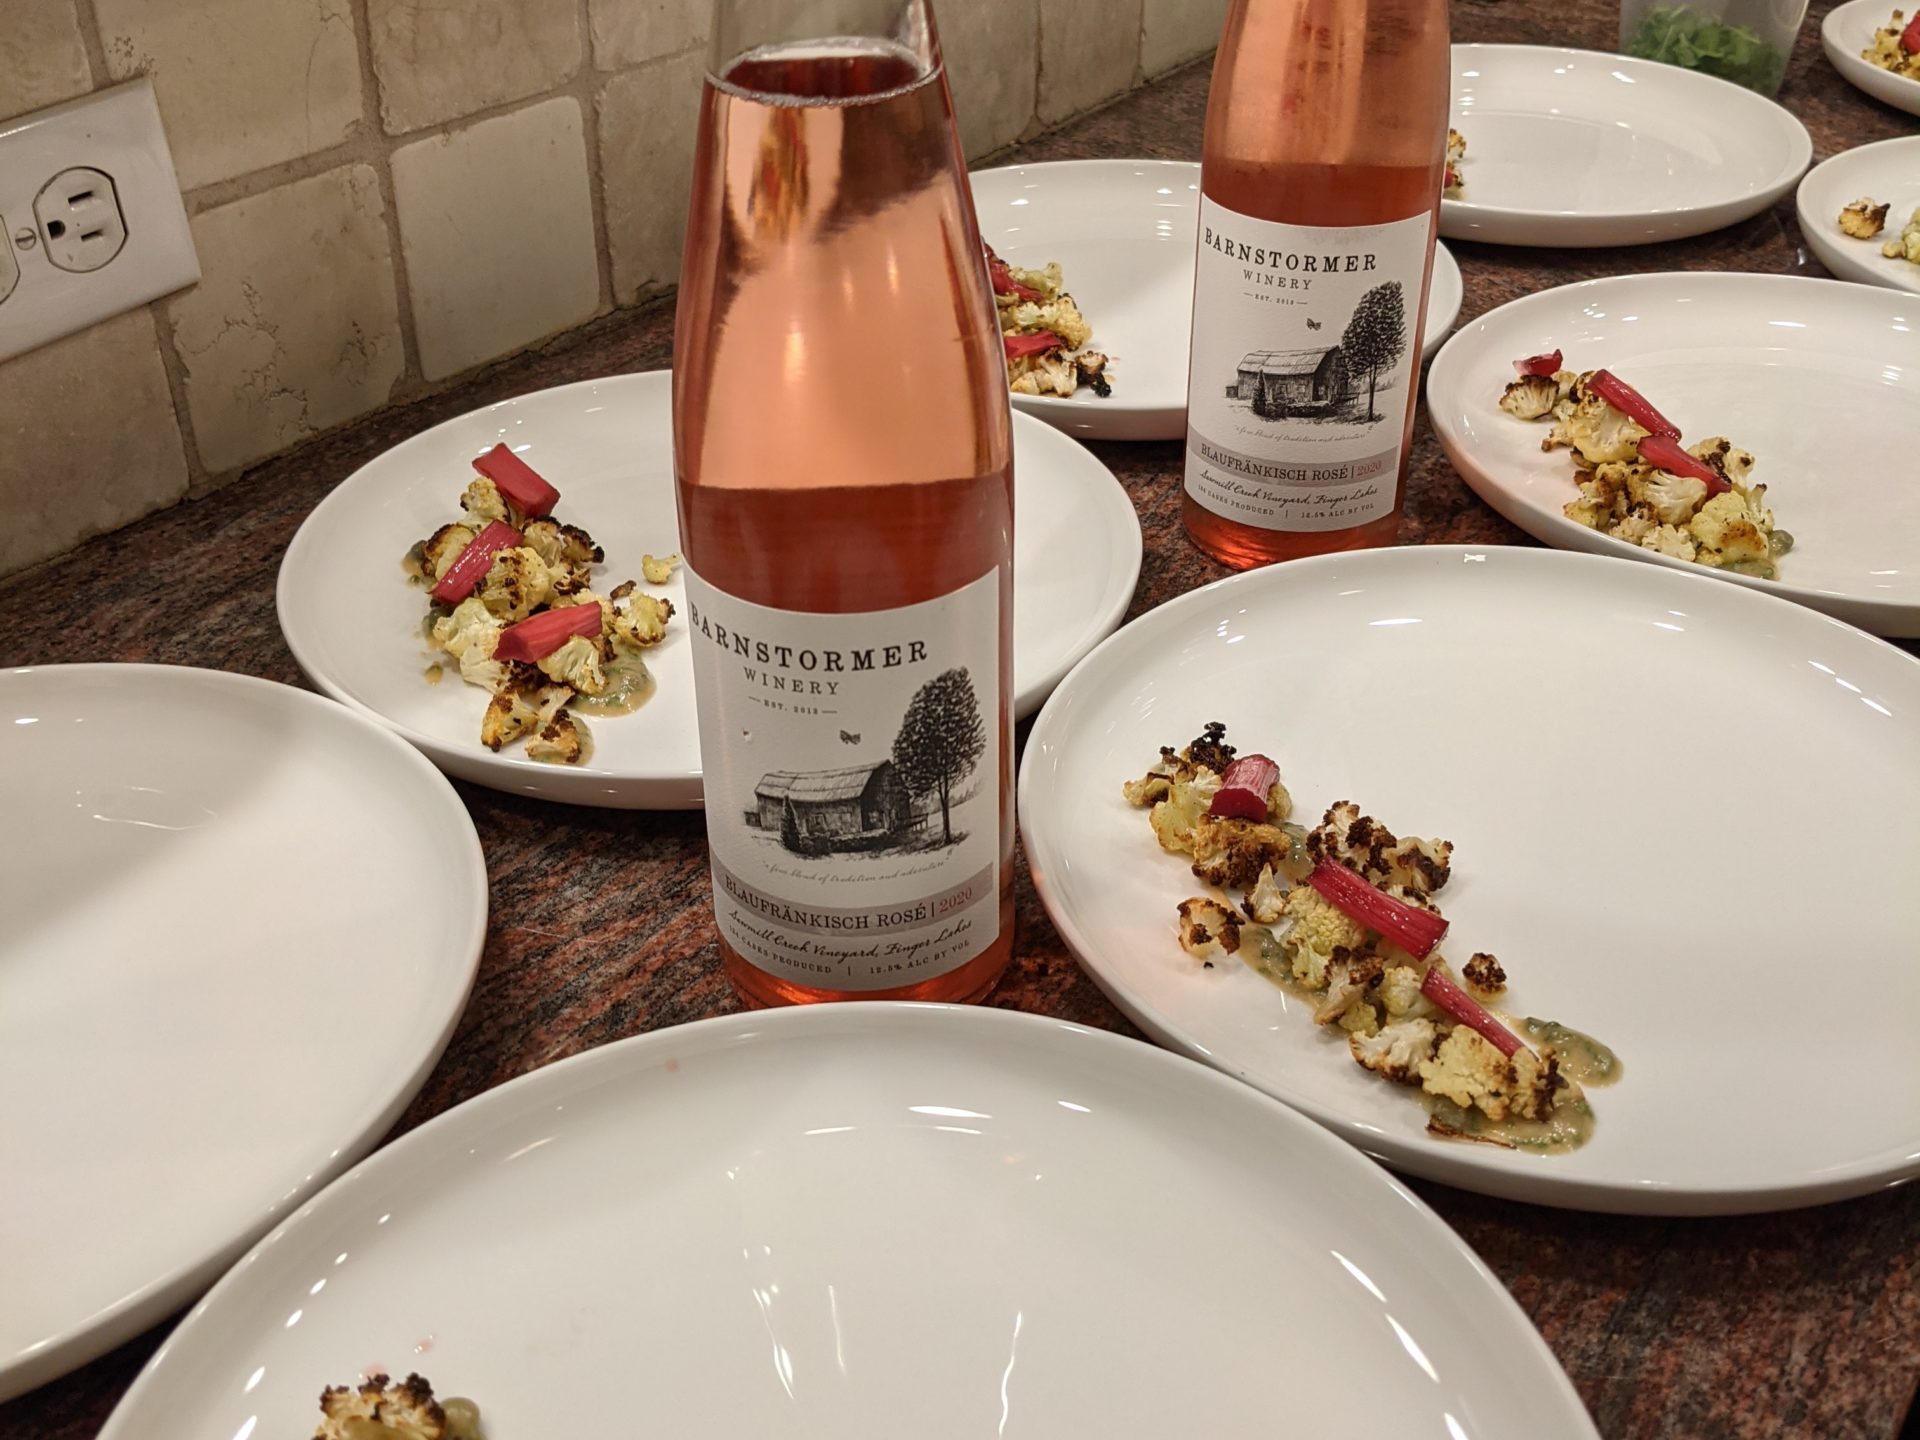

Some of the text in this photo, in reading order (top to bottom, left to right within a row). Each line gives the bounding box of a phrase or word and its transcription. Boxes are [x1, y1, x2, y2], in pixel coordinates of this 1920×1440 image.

[1205, 227, 1376, 273] BARNSTORMER
[1243, 269, 1313, 290] WINERY
[1201, 443, 1382, 481] BLAUFRÄNKISCH ROSÉ 2020
[1200, 470, 1234, 491] Sawmill
[1234, 484, 1262, 498] Creek
[1313, 494, 1348, 509] Finger
[1350, 484, 1378, 500] Lakes
[1230, 500, 1274, 516] PRODUCED
[1328, 510, 1345, 518] ALC
[690, 601, 927, 672] BARNSTORMER
[743, 667, 840, 695] WINERY
[764, 699, 788, 711] EST.
[725, 875, 973, 930] BLAUFRÄNKISCH ROSÉ 2020
[729, 909, 972, 965] Sawmill Creek Vineyard, Finger Lakes
[741, 935, 769, 957] CASES
[772, 953, 832, 974] PRODUCED
[870, 964, 903, 975] 12.5%
[907, 956, 929, 969] ALC
[934, 950, 948, 962] BY
[952, 939, 971, 953] VOL
